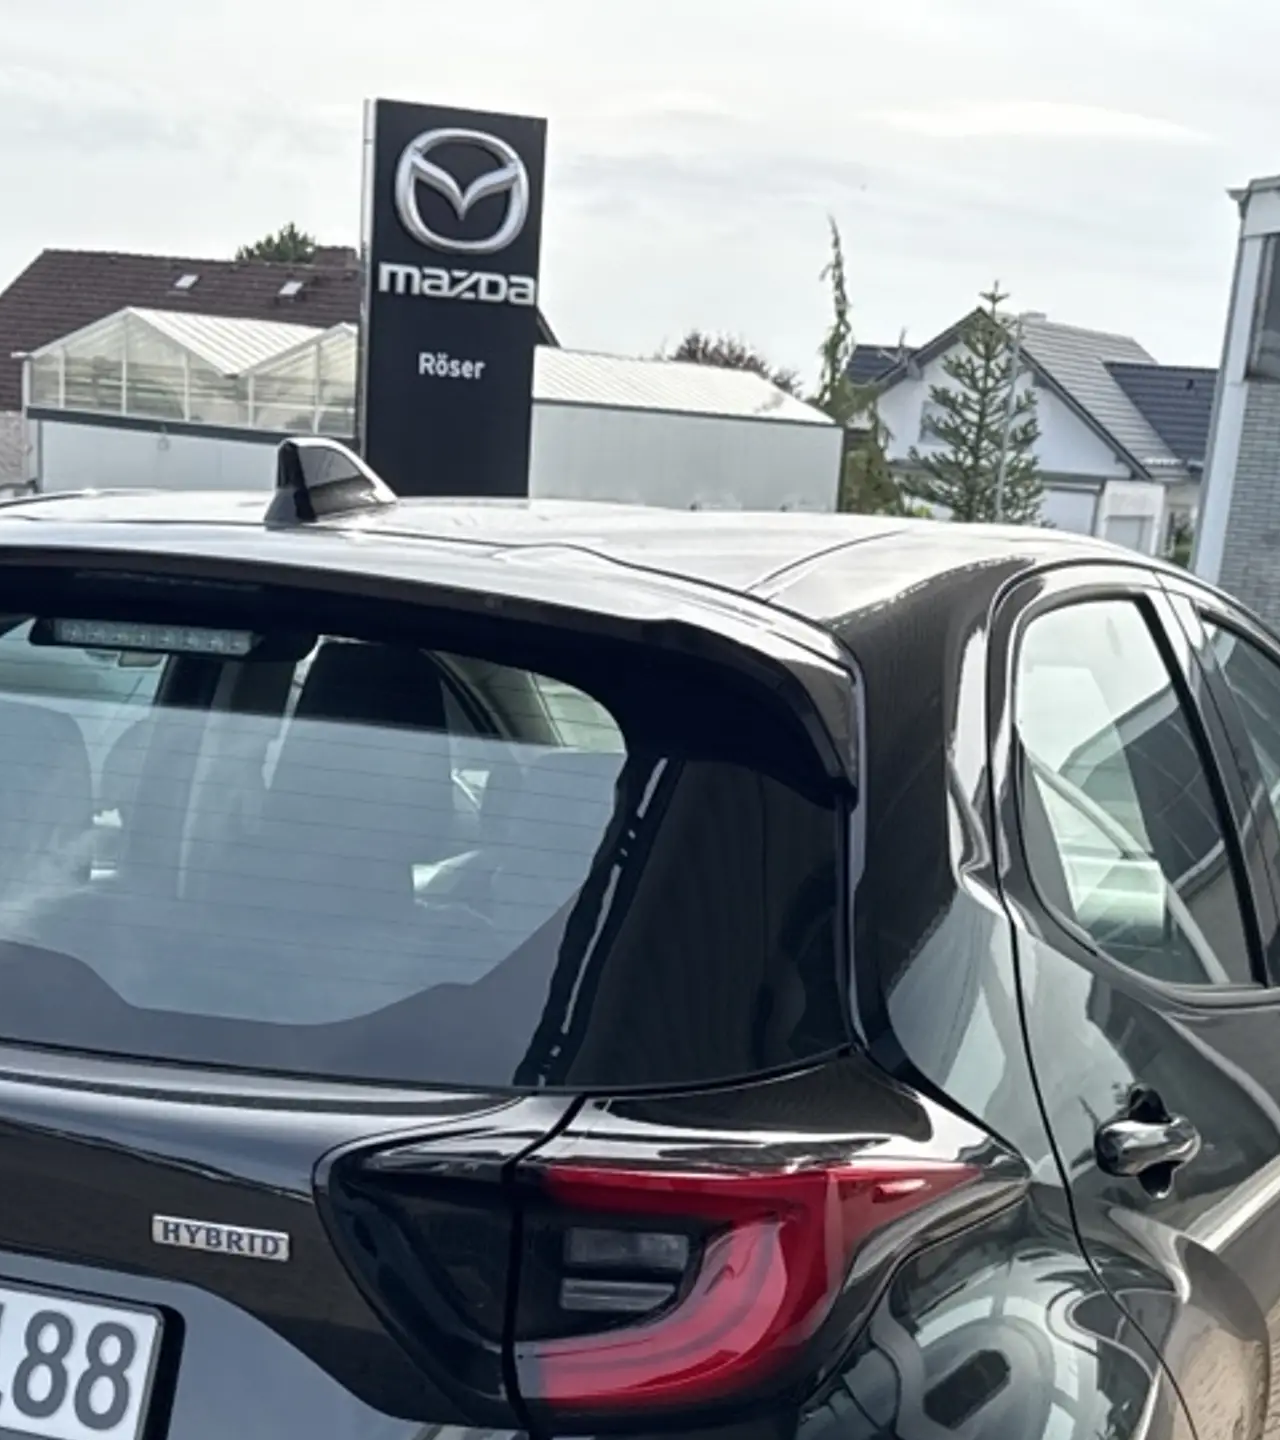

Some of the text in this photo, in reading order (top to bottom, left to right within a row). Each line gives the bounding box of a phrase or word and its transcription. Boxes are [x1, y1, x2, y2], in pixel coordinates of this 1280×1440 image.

[377, 261, 536, 306] mazda
[418, 352, 486, 379] Röser
[161, 1219, 281, 1257] HYBRID
